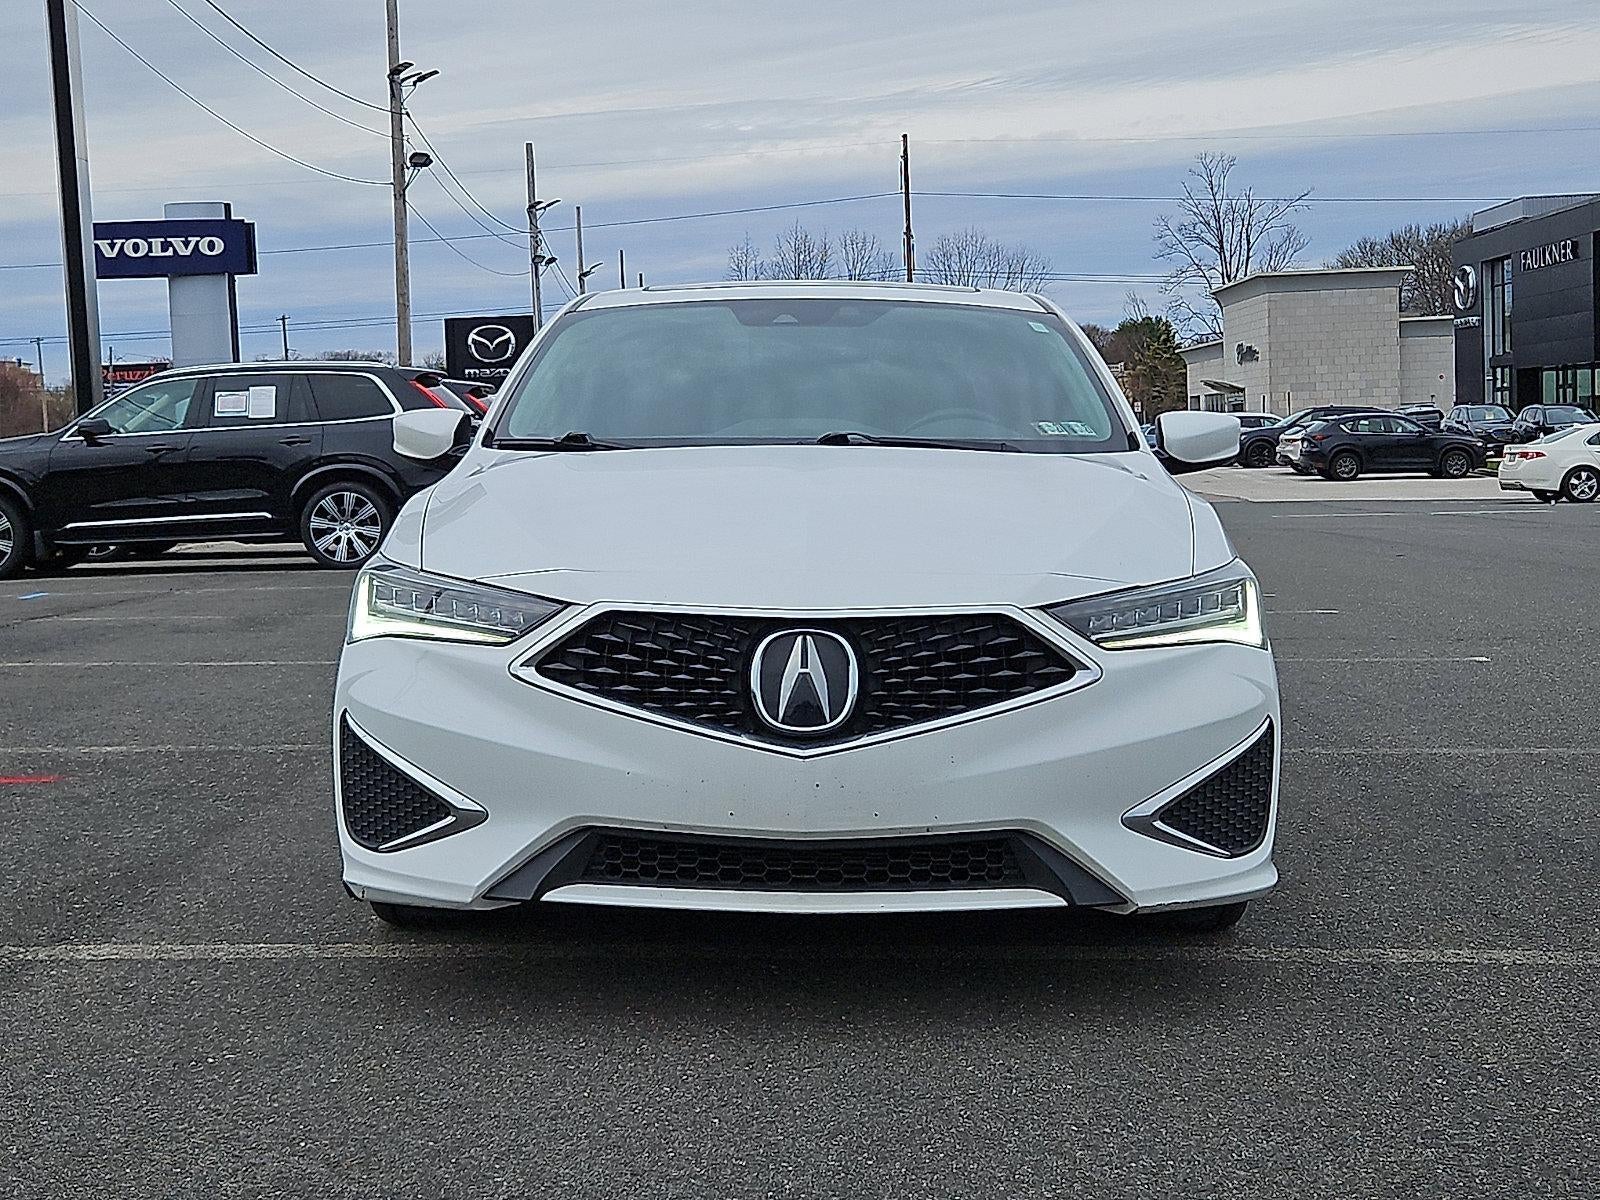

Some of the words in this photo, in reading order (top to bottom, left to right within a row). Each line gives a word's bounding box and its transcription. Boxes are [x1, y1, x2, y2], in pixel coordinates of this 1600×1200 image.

[94, 236, 225, 258] VOLVO
[1520, 239, 1574, 272] FAULKNER
[464, 368, 511, 378] mazd
